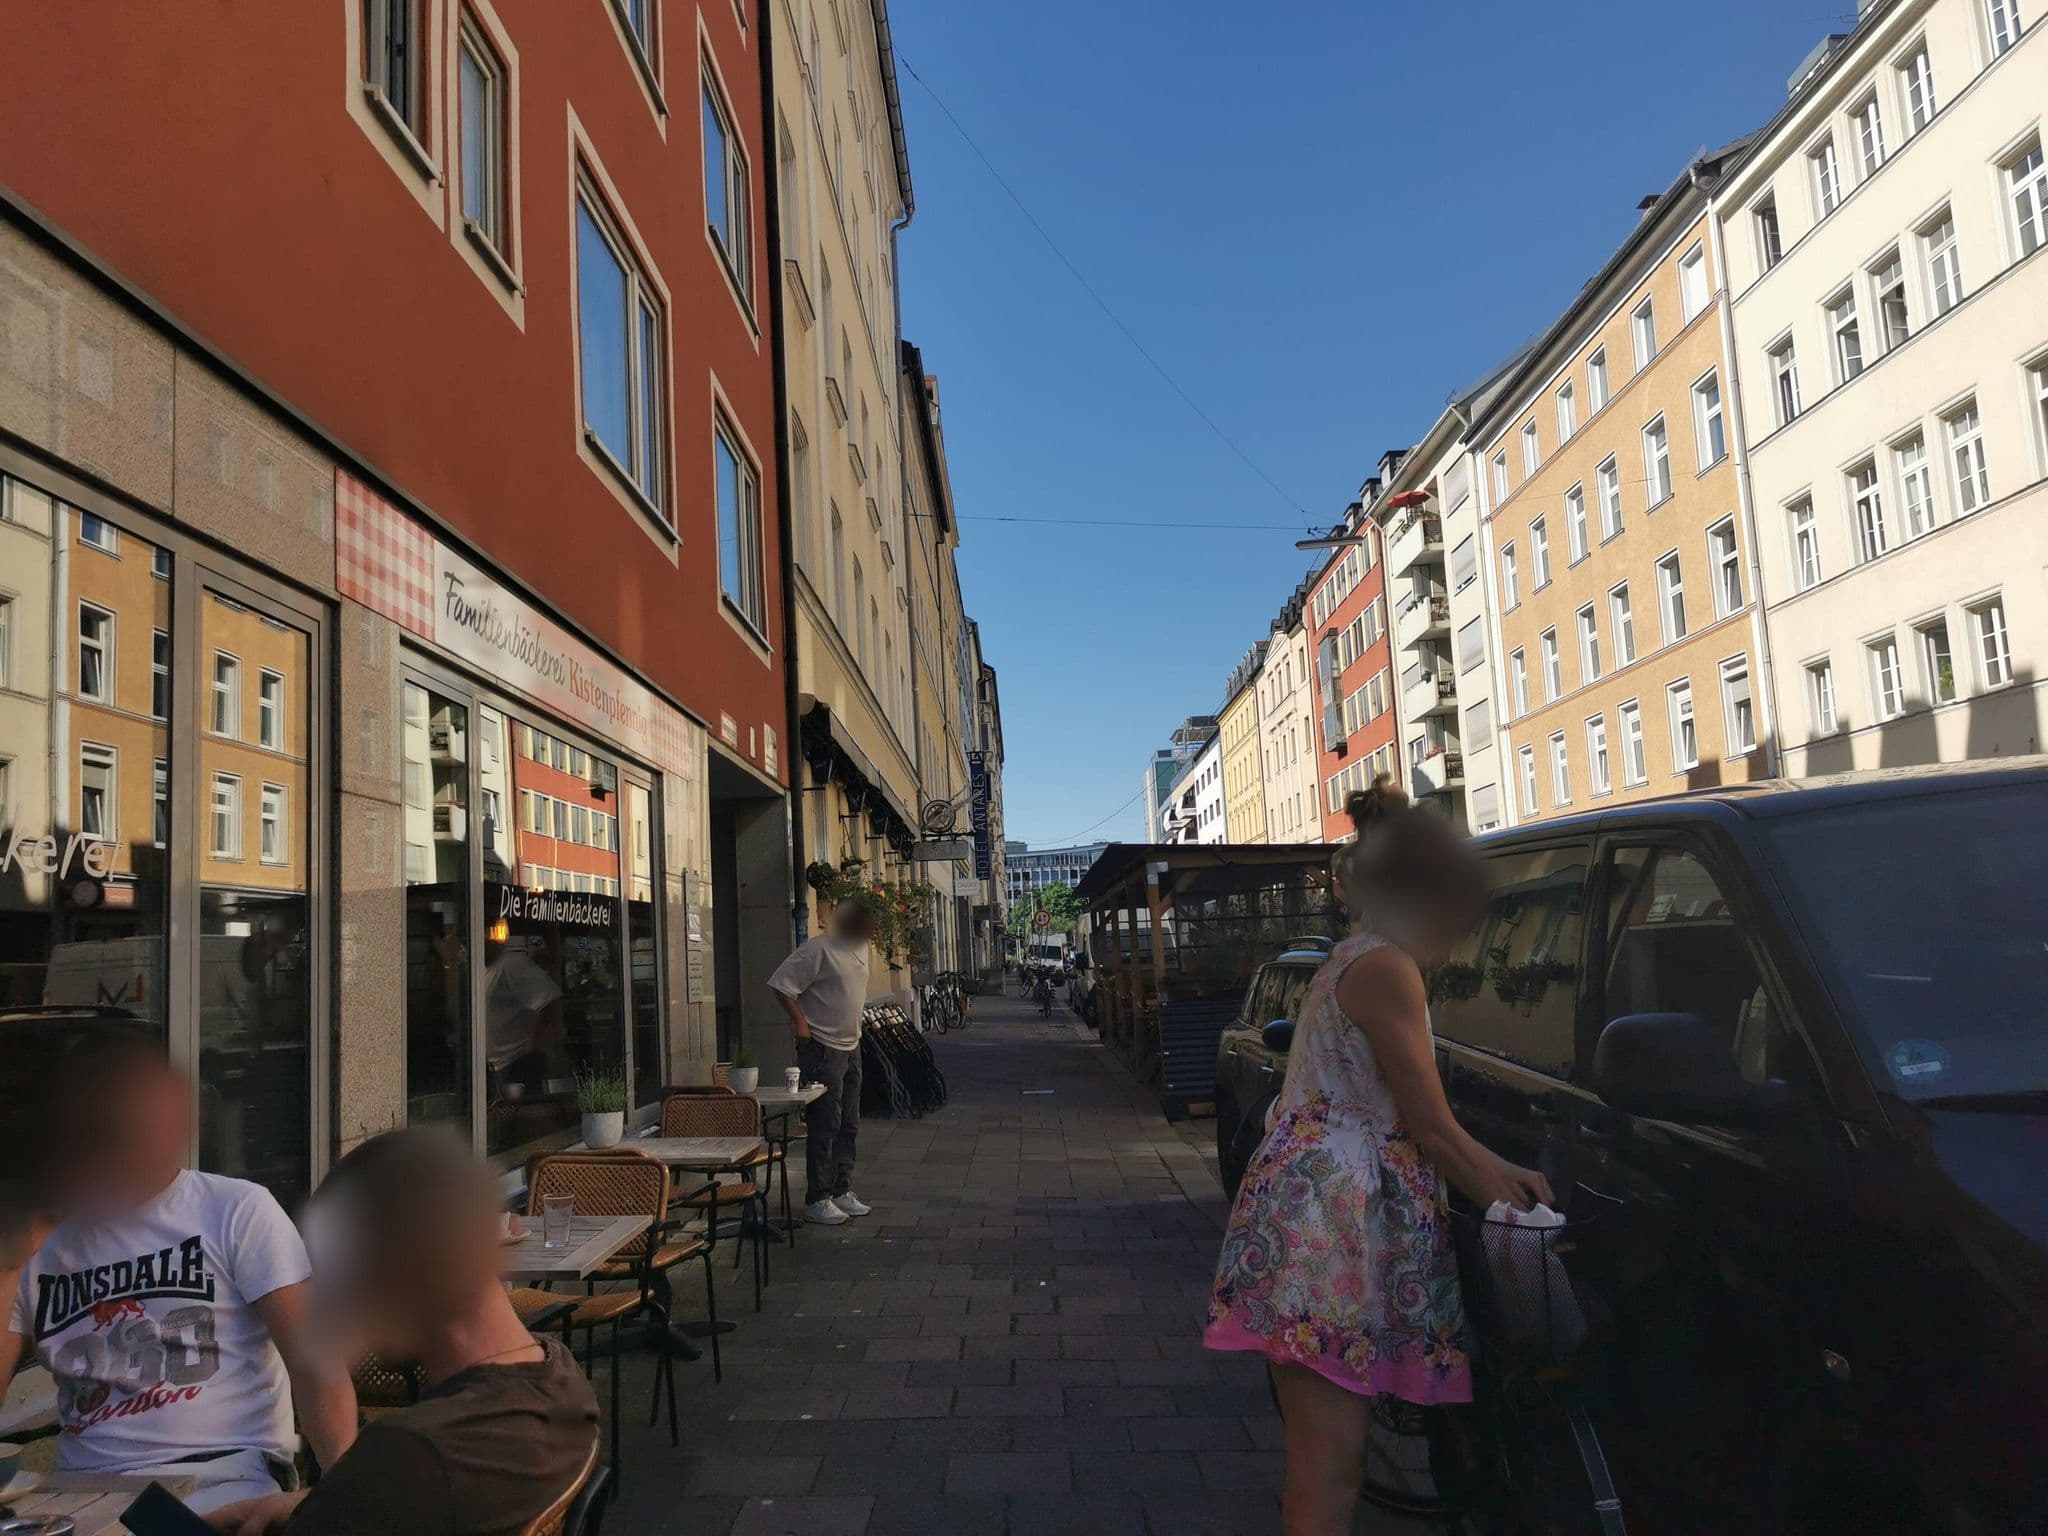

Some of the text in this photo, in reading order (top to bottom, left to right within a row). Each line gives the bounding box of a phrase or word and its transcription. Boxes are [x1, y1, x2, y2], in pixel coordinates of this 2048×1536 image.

[443, 570, 649, 741] Familienbäckerei Kistenpfennig
[0, 803, 121, 883] kerei
[972, 772, 990, 881] HOTEL ANTARES
[499, 884, 522, 918] Die
[34, 1235, 214, 1341] LONSDALE
